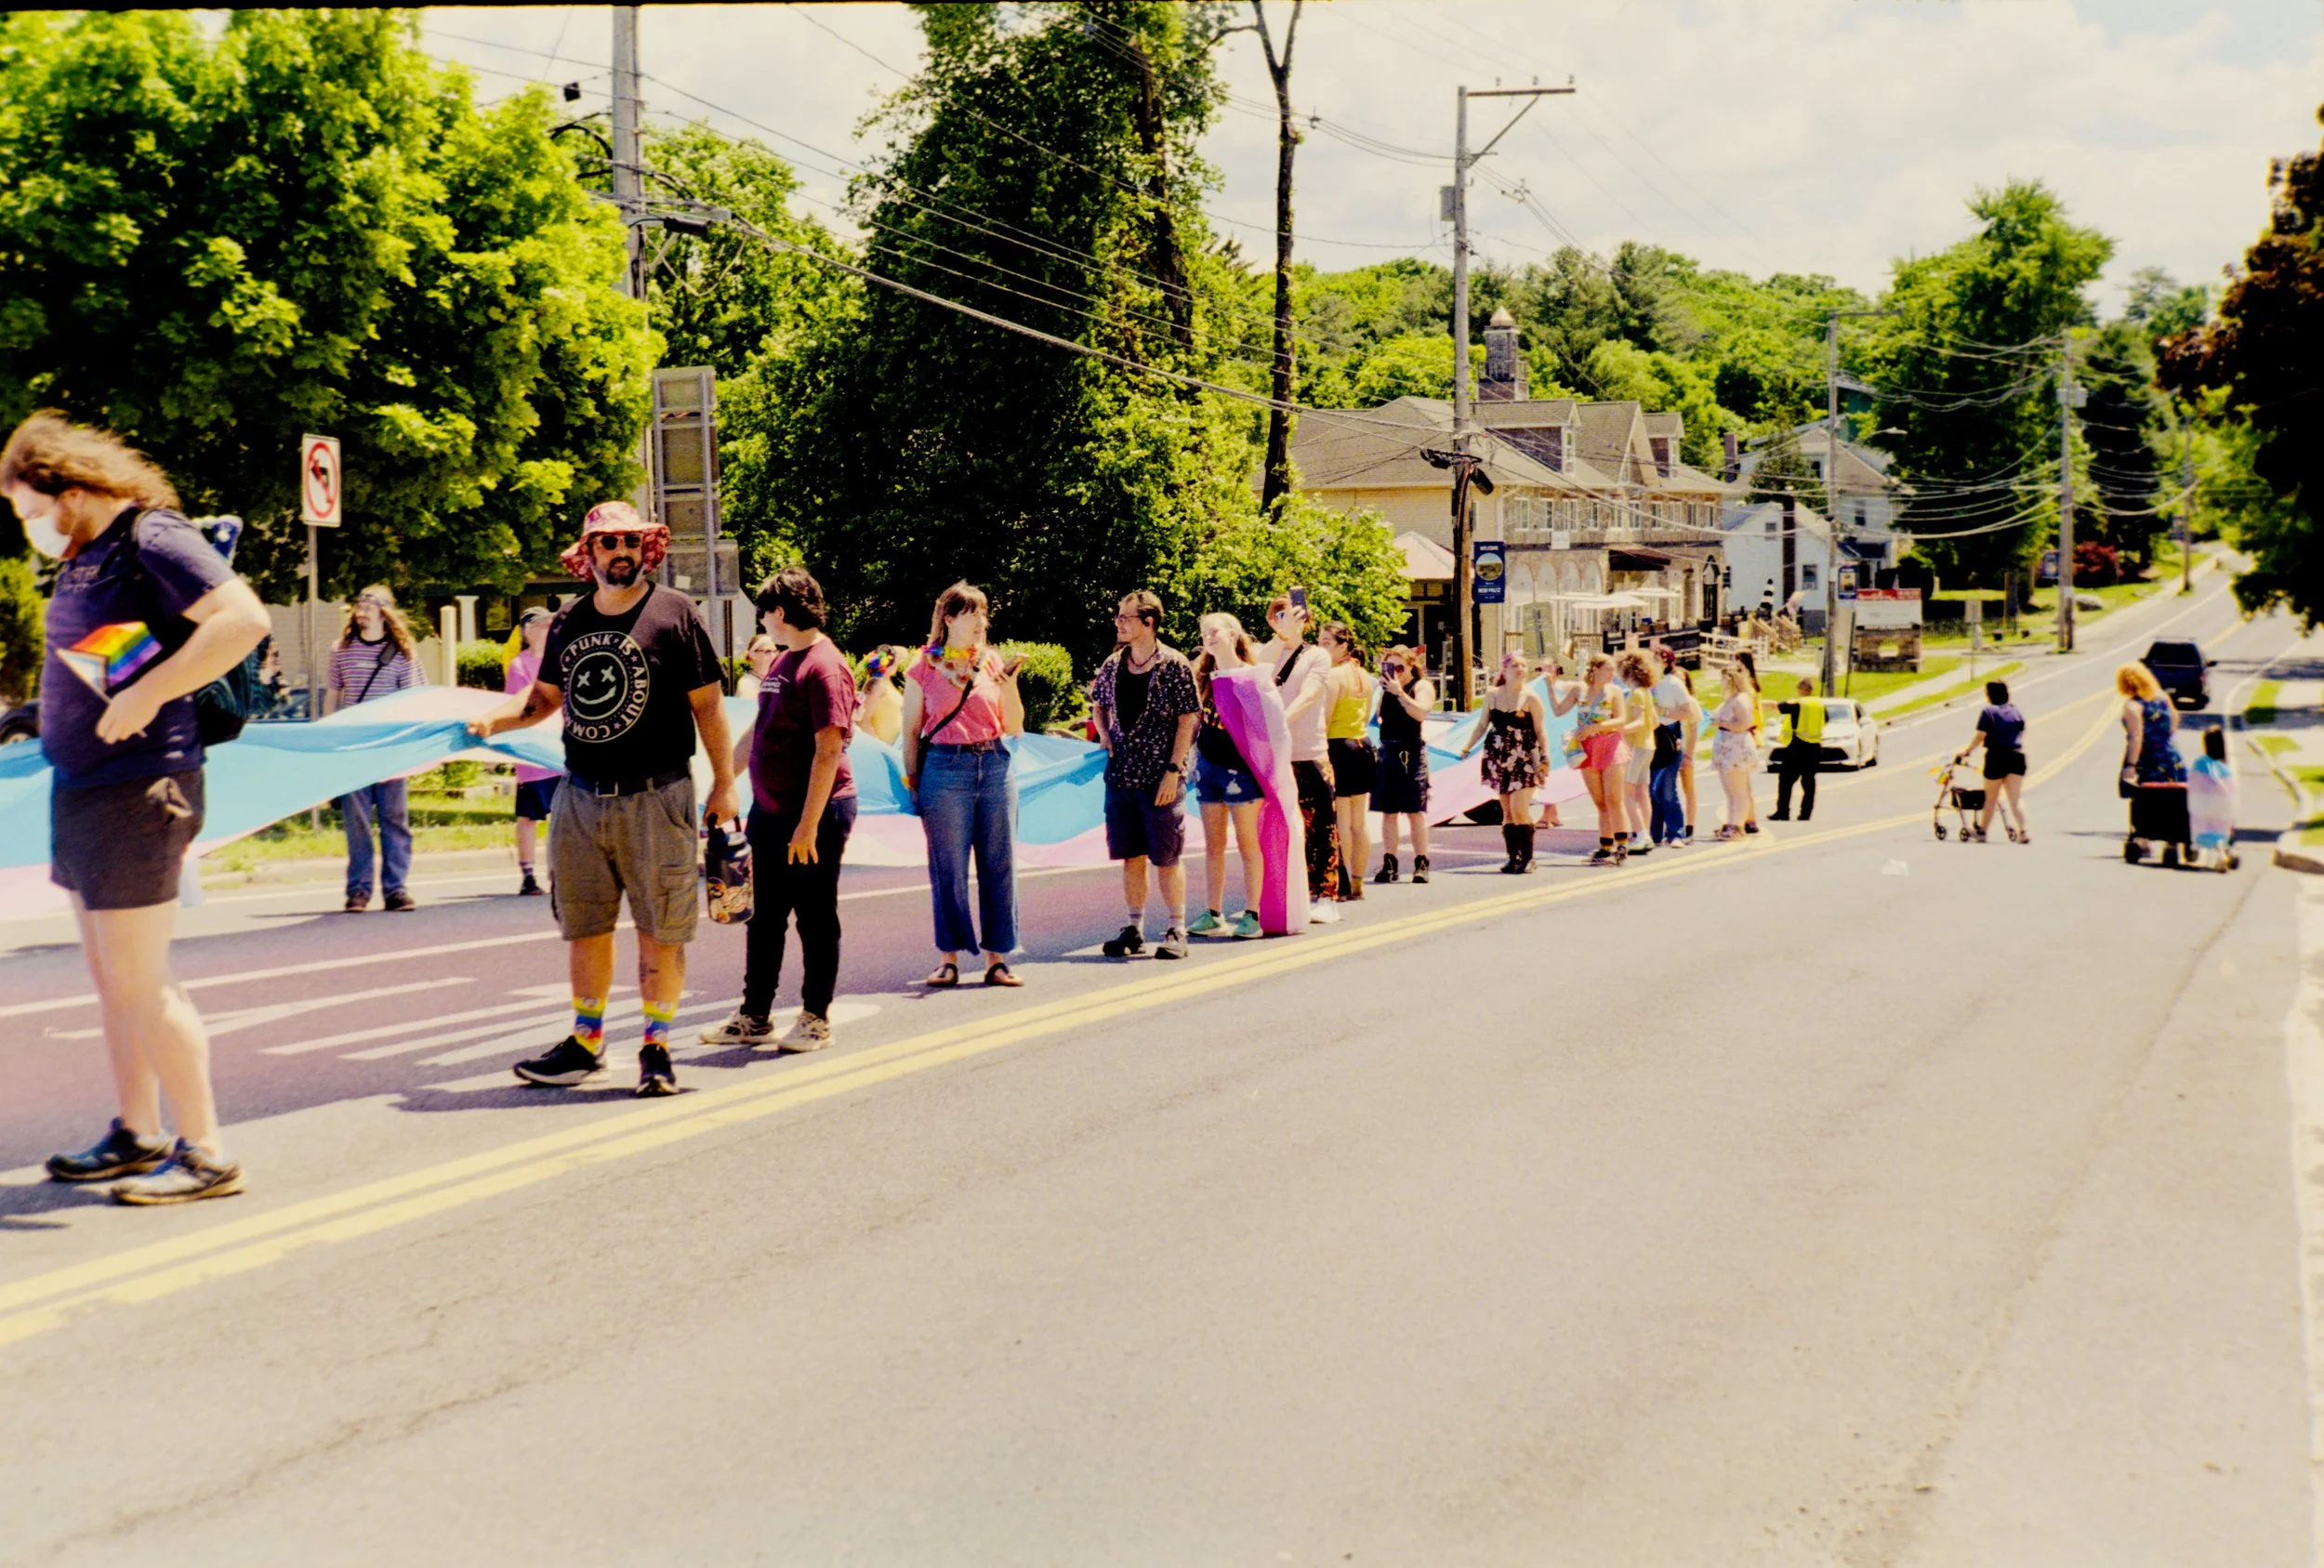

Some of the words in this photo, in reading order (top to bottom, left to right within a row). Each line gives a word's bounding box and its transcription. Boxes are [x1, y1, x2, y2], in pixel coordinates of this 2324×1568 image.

[569, 634, 614, 656] PUNK
[618, 638, 635, 656] IS
[620, 665, 648, 727] ABOUT
